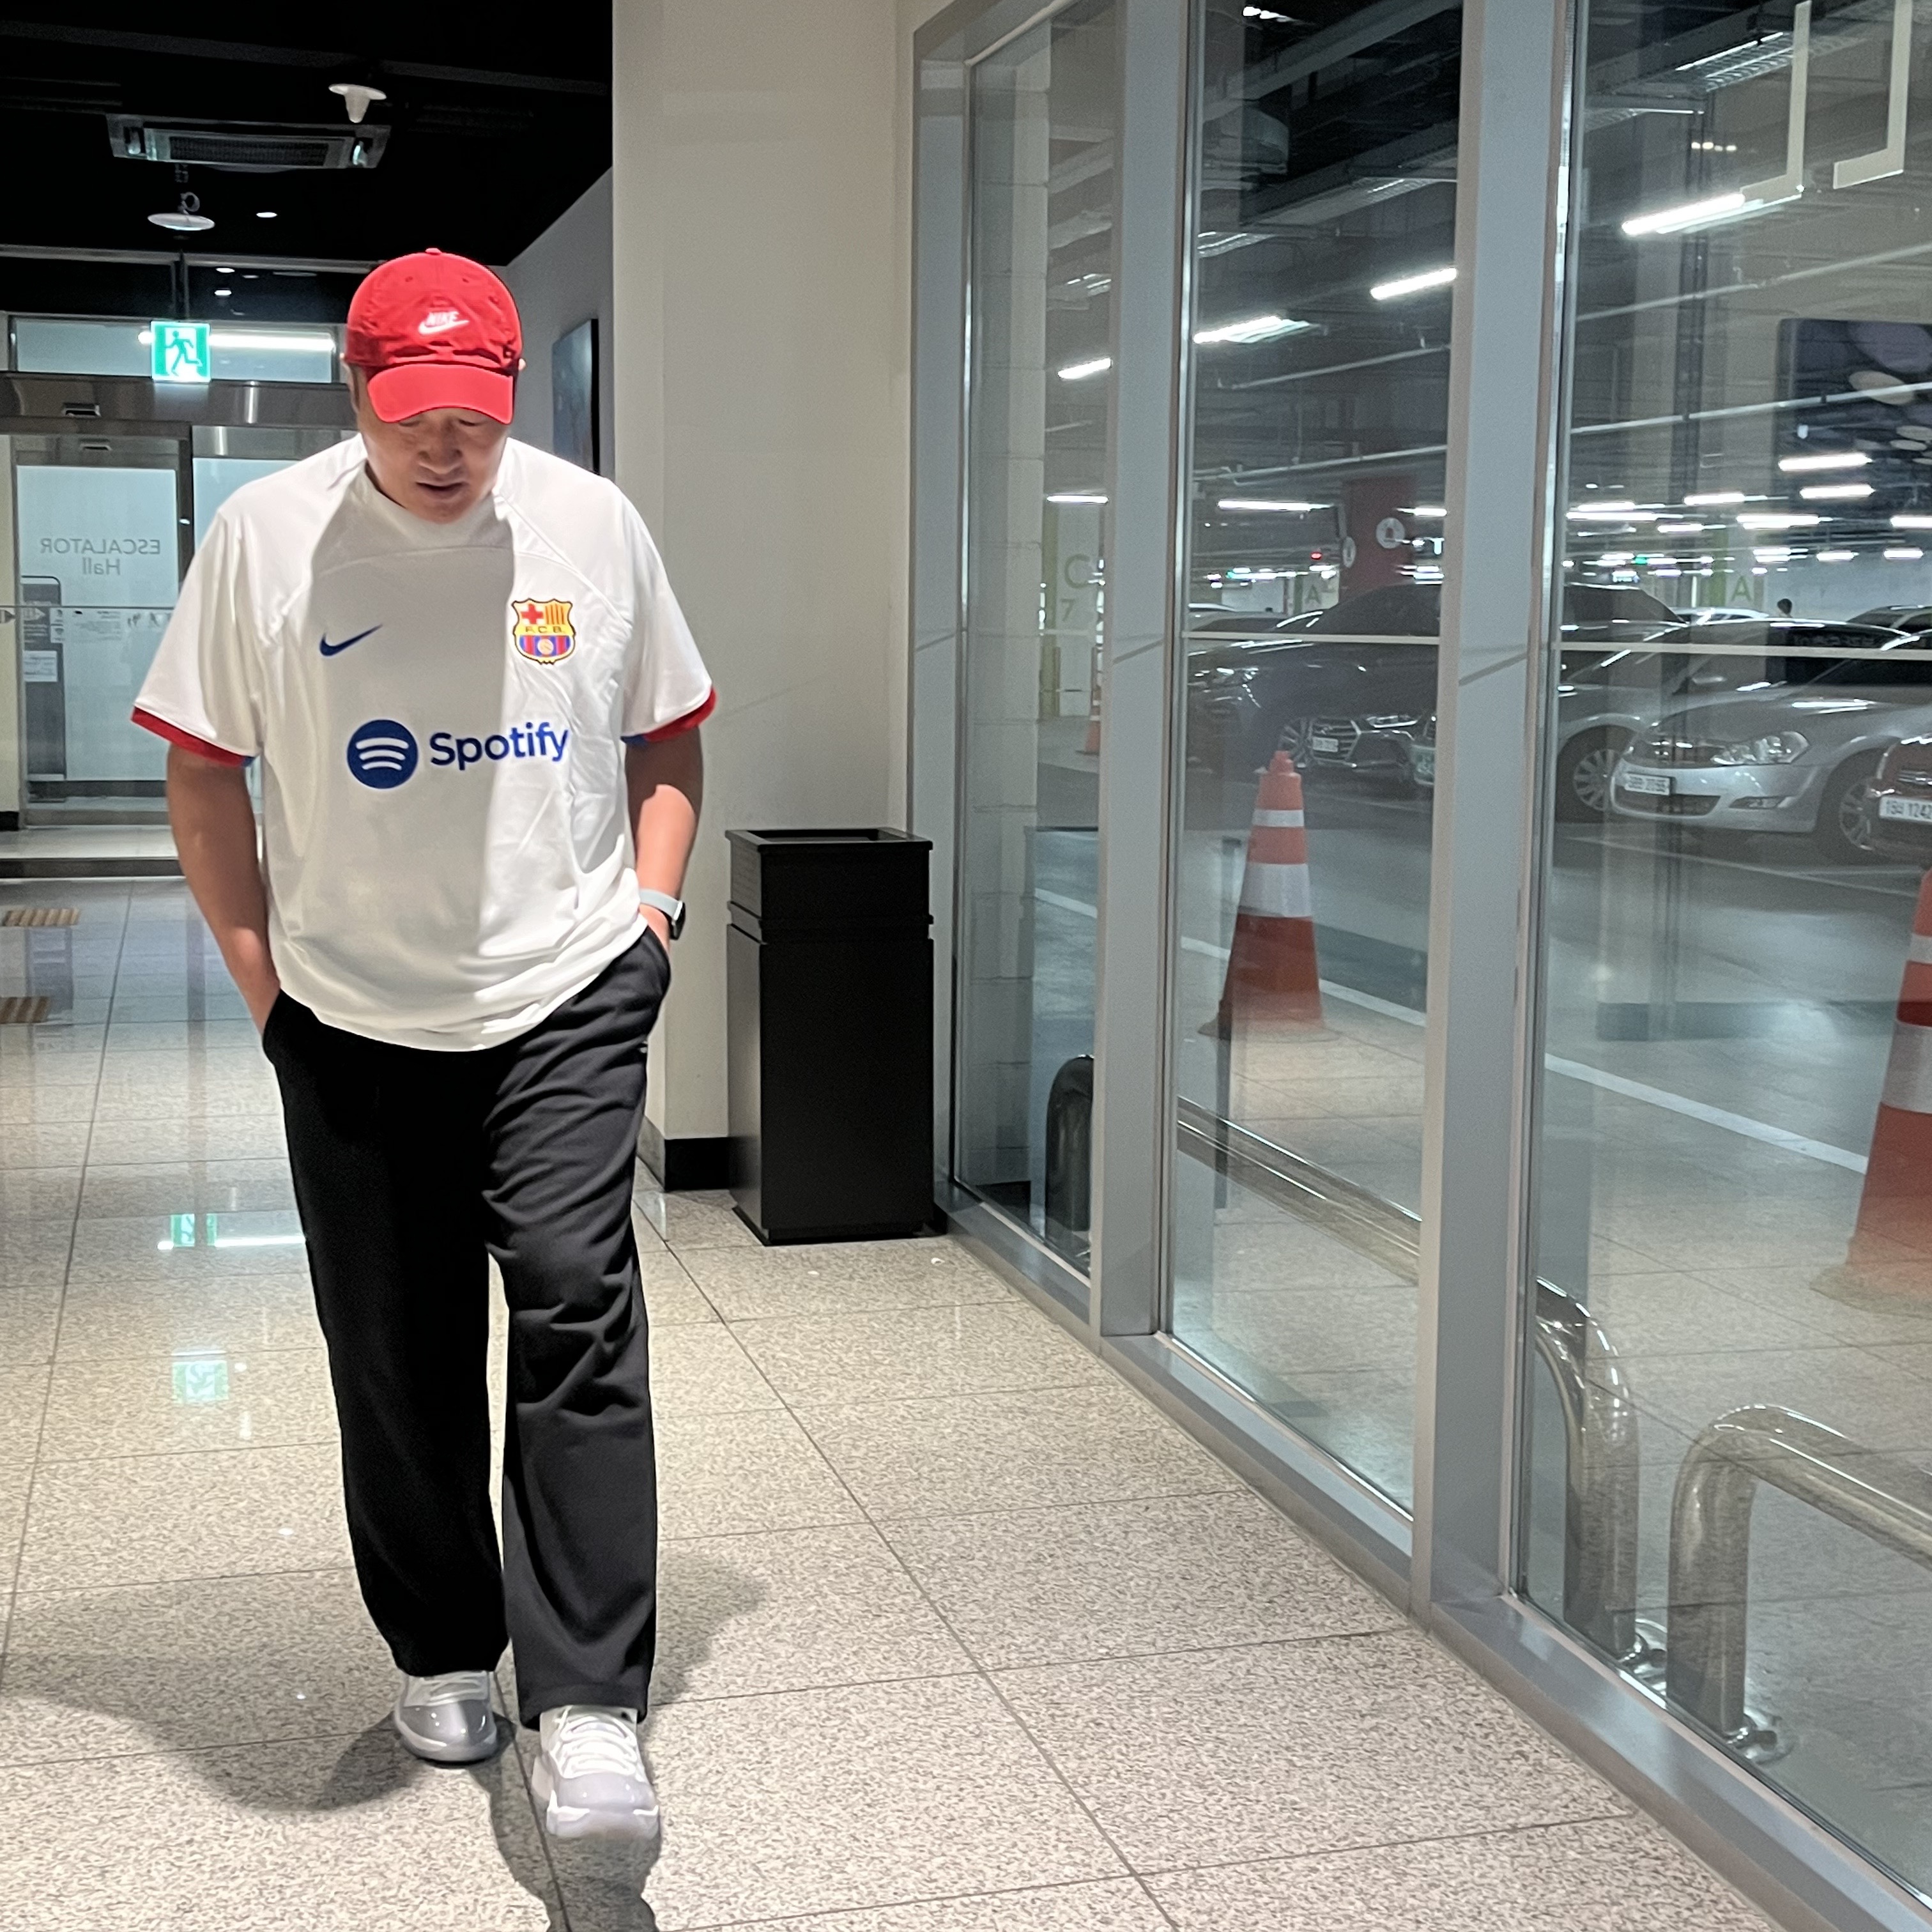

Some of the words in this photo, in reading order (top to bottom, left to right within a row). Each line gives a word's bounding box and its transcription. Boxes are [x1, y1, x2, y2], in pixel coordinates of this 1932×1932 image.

[424, 310, 459, 327] NIKE
[1064, 554, 1093, 588] C
[1305, 585, 1322, 604] A
[1730, 576, 1752, 601] A
[1061, 599, 1075, 622] 7
[429, 721, 569, 770] Spotify
